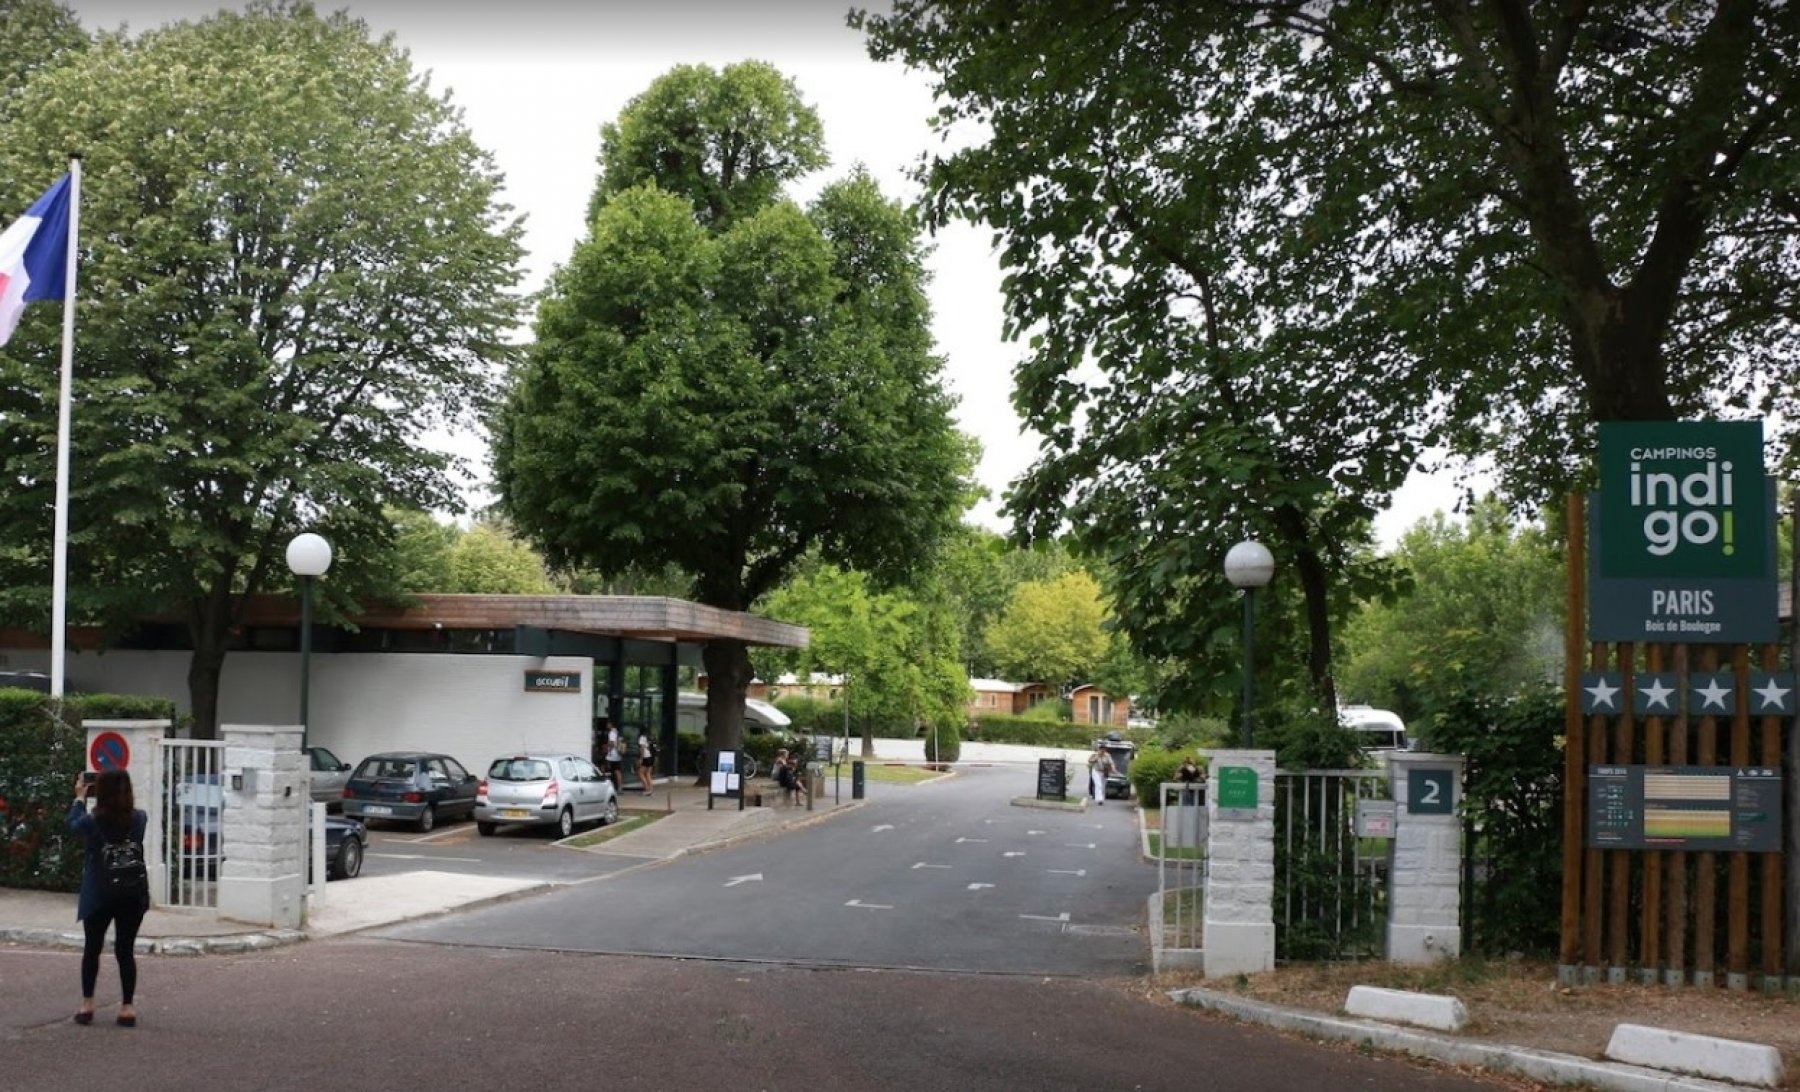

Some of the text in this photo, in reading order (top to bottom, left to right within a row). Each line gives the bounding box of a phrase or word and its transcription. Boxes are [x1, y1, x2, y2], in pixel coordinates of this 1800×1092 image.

[1630, 447, 1717, 460] CAMPINGS
[1630, 461, 1733, 506] indi
[1644, 510, 1734, 556] go!
[1652, 589, 1715, 615] PARIS
[1645, 620, 1721, 635] Bois de Boulogne
[535, 675, 569, 687] accueil
[1421, 779, 1440, 804] 2
